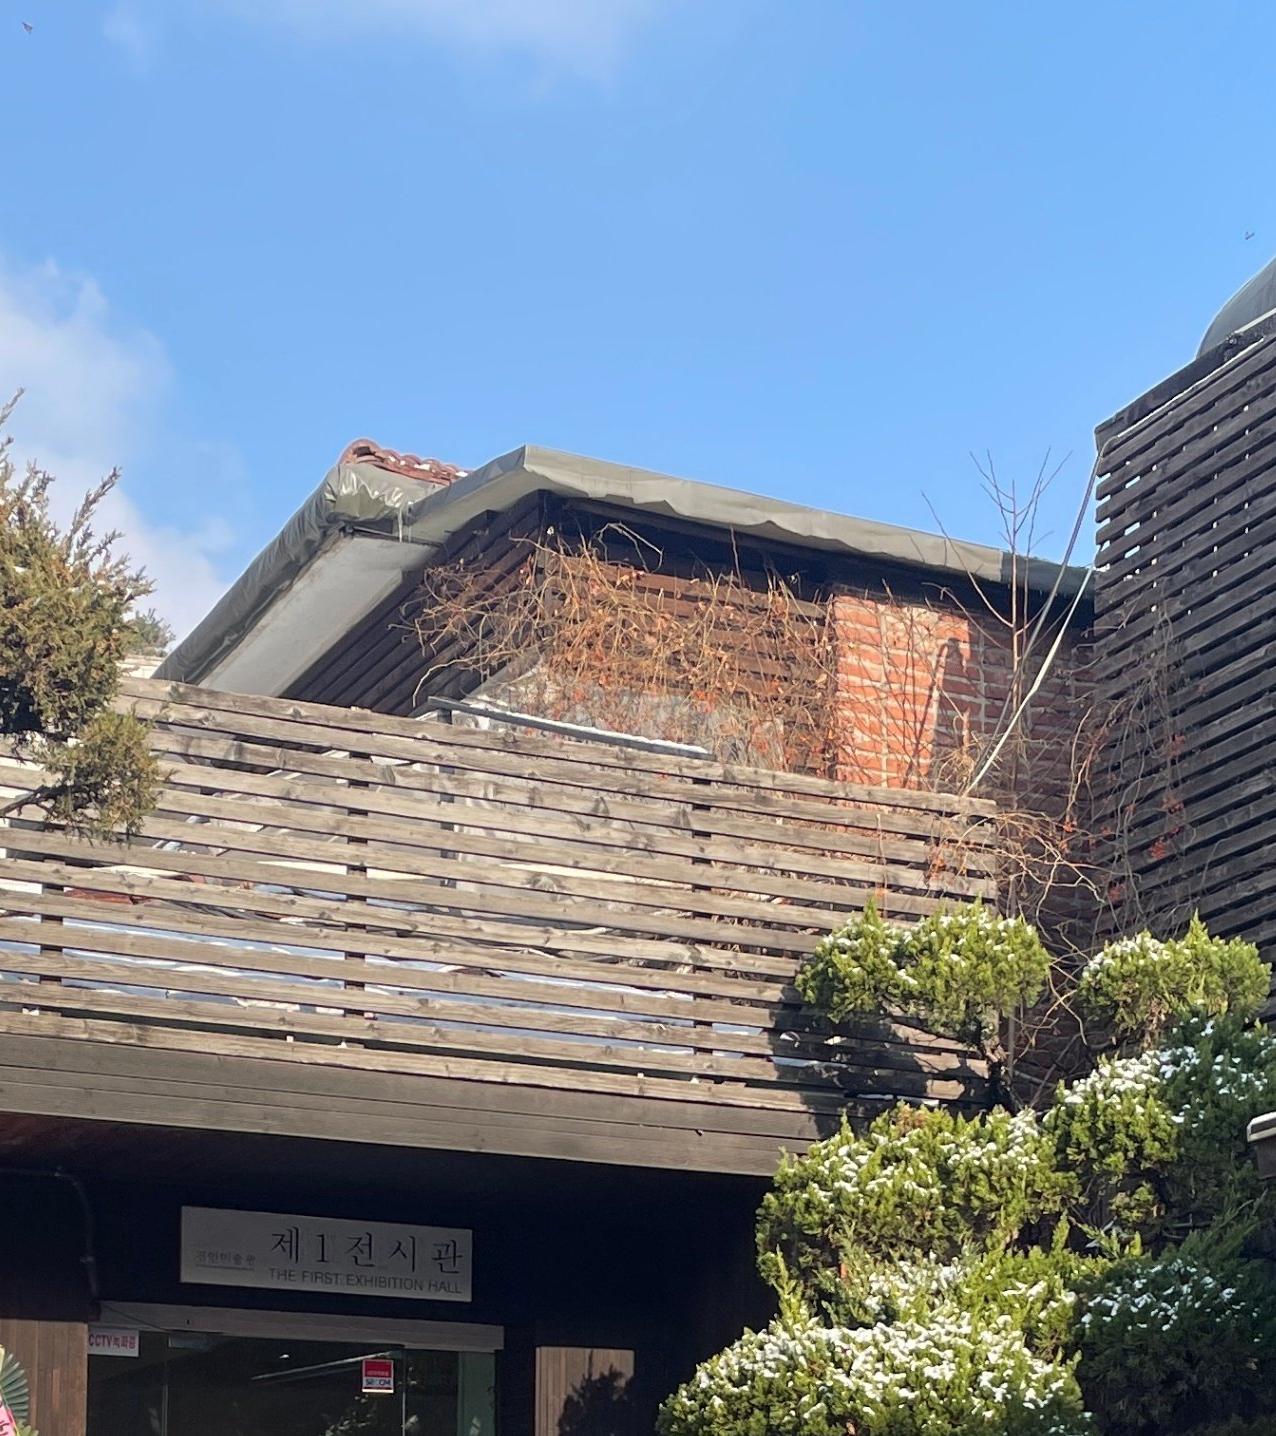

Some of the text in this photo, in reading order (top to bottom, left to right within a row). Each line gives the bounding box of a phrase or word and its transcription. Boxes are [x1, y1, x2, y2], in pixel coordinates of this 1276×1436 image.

[270, 1268, 462, 1295] THE FIRST EXHIBITION HALL
